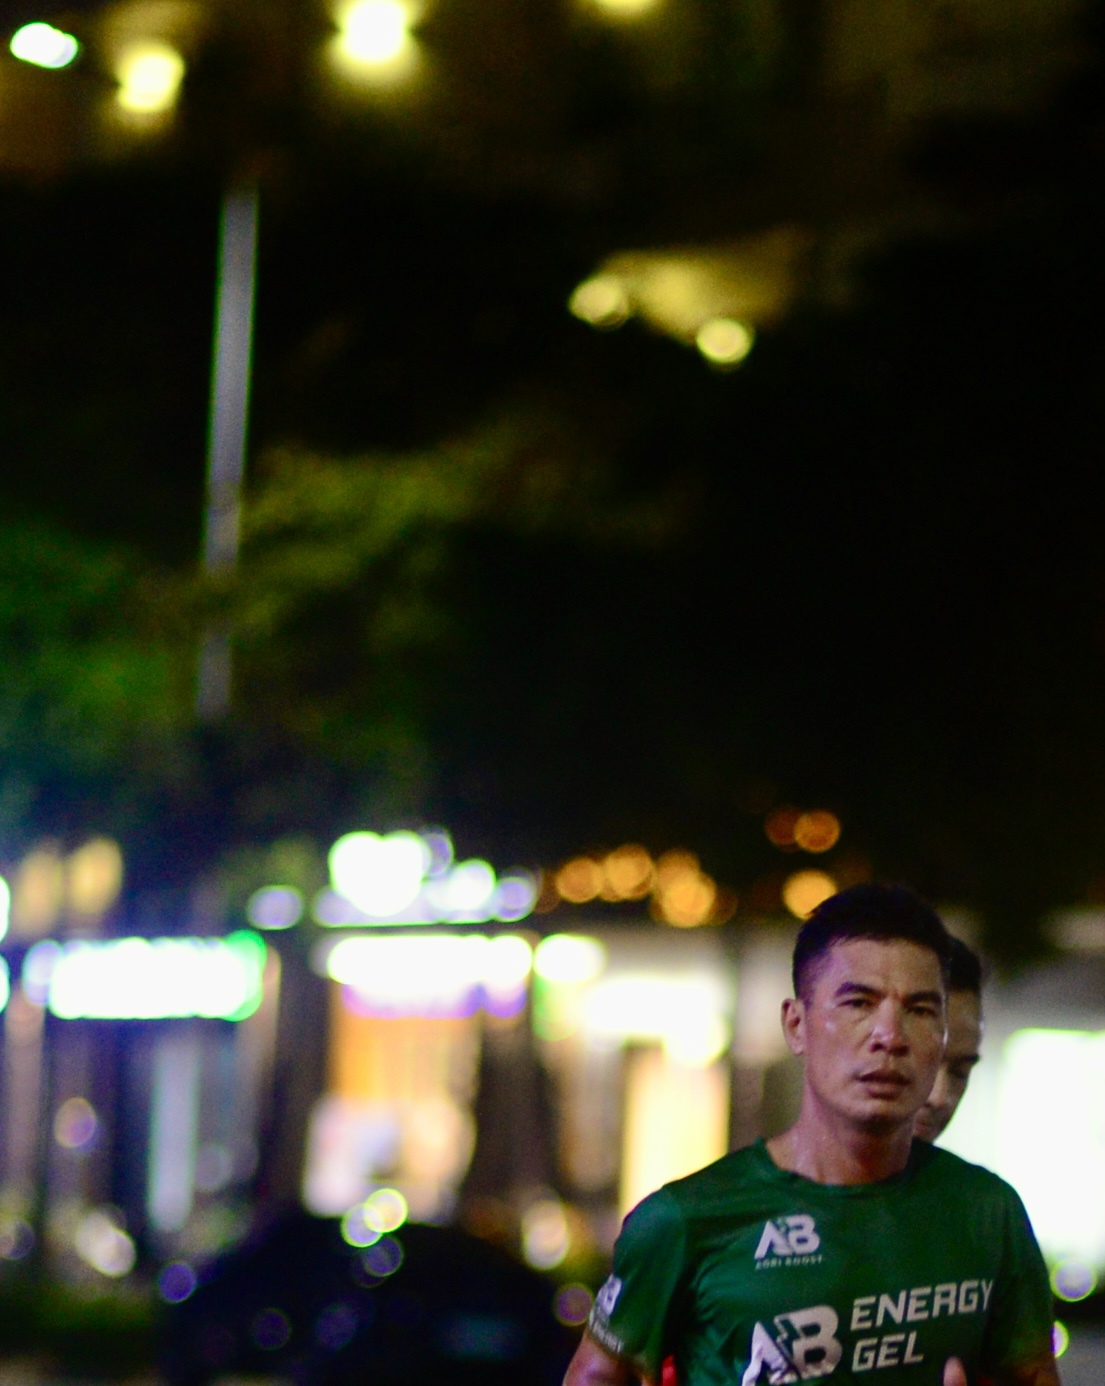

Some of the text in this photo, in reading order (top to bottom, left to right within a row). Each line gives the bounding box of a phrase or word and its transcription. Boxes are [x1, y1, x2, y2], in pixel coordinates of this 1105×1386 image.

[754, 1214, 820, 1259] AB
[851, 1279, 993, 1331] ENERGY
[852, 1331, 924, 1373] GEL
